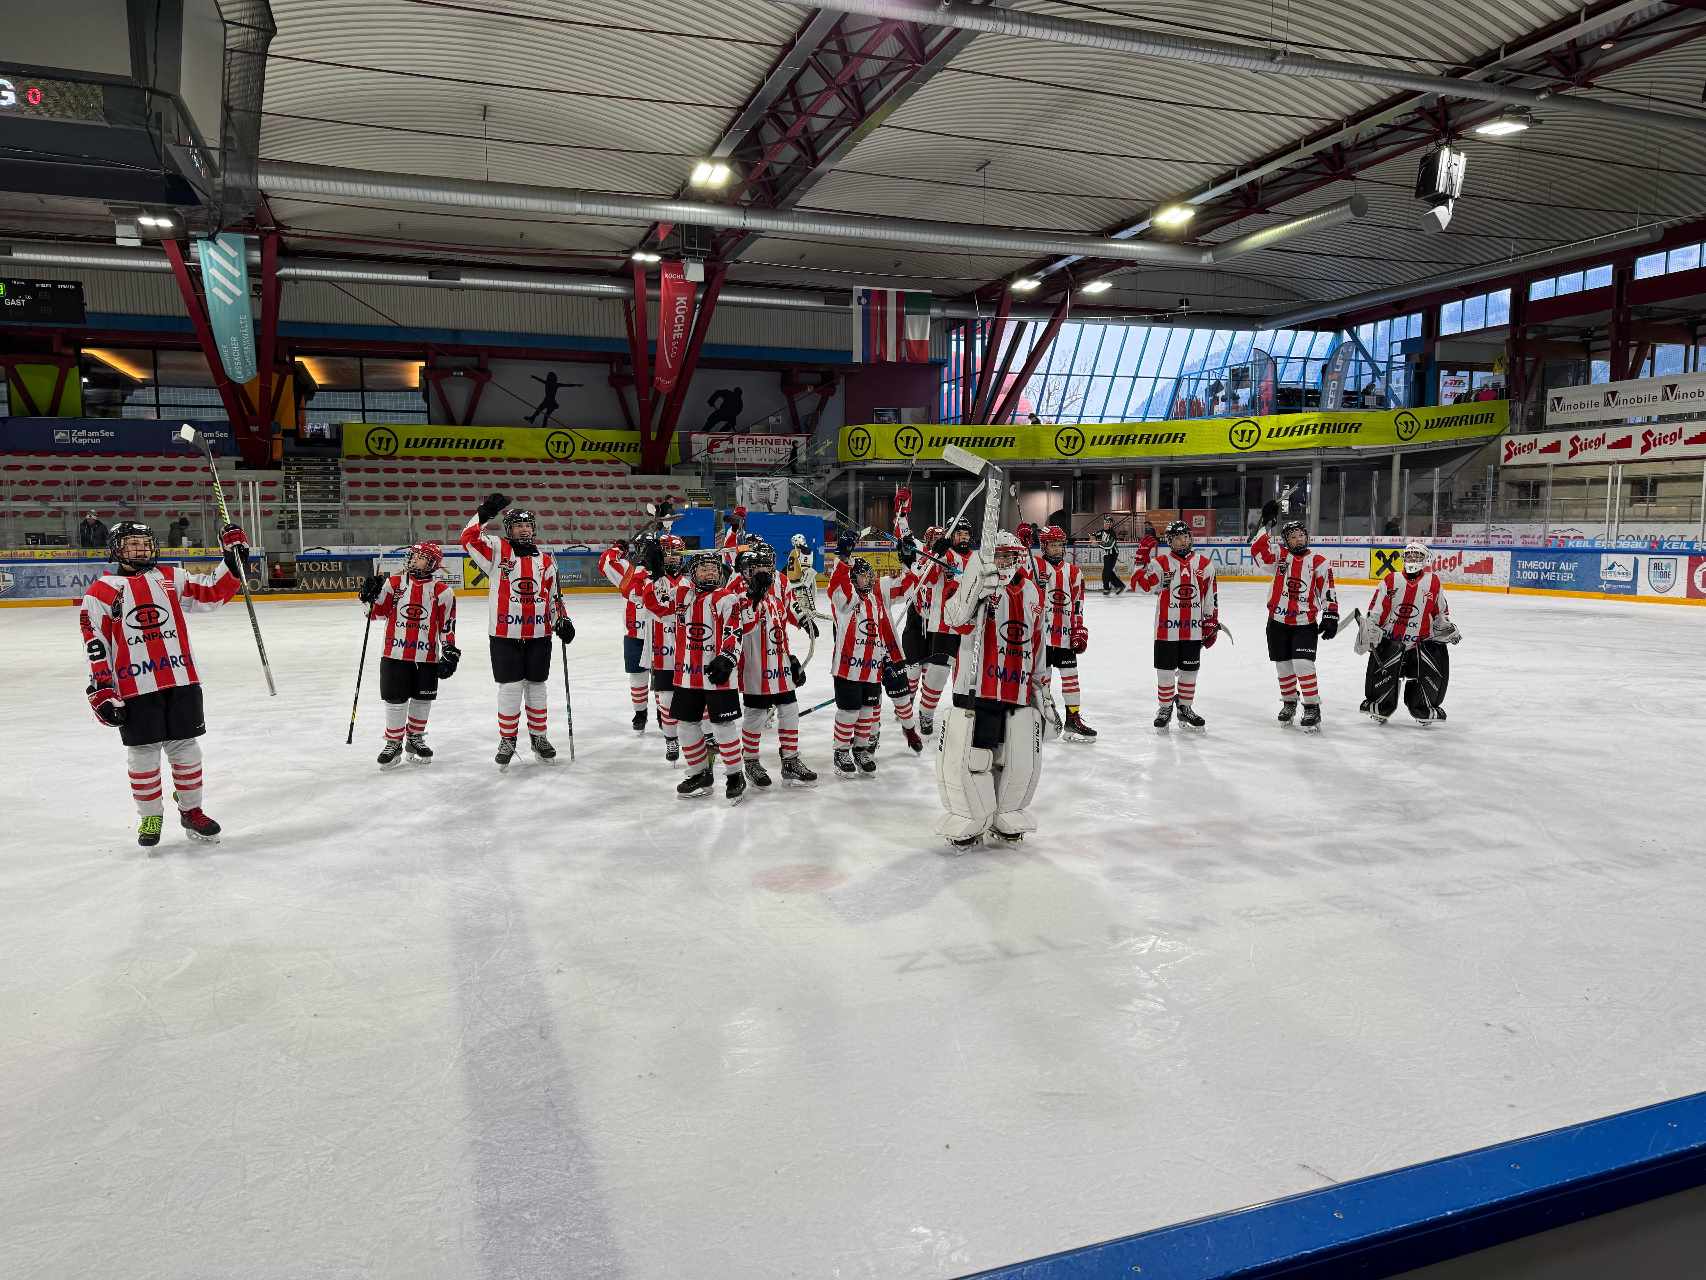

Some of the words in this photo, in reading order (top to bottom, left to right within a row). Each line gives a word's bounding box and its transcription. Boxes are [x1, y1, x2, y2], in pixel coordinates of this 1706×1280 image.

[1551, 396, 1600, 413] Vinobile
[1603, 390, 1658, 408] Vinobile
[1424, 412, 1496, 430] WARRIOR
[1267, 422, 1362, 439] WARRIOR
[72, 437, 101, 445] Kaprun
[404, 437, 504, 450] WARRIOR
[580, 440, 641, 453] WARR
[737, 438, 792, 446] FAHNEN
[928, 436, 1016, 448] WARRIOR
[1090, 432, 1187, 447] WARRIOR
[1568, 432, 1607, 460] Stiegl
[1640, 426, 1683, 457] Stiegl
[1504, 438, 1538, 464] Stiegl
[1181, 567, 1190, 577] A
[1517, 560, 1558, 570] TIMEOUT
[1559, 561, 1579, 571] AUF
[1653, 562, 1664, 571] ALL
[23, 575, 67, 589] ZELL
[1160, 619, 1203, 629] COMARC
[127, 629, 177, 646] CANPACK
